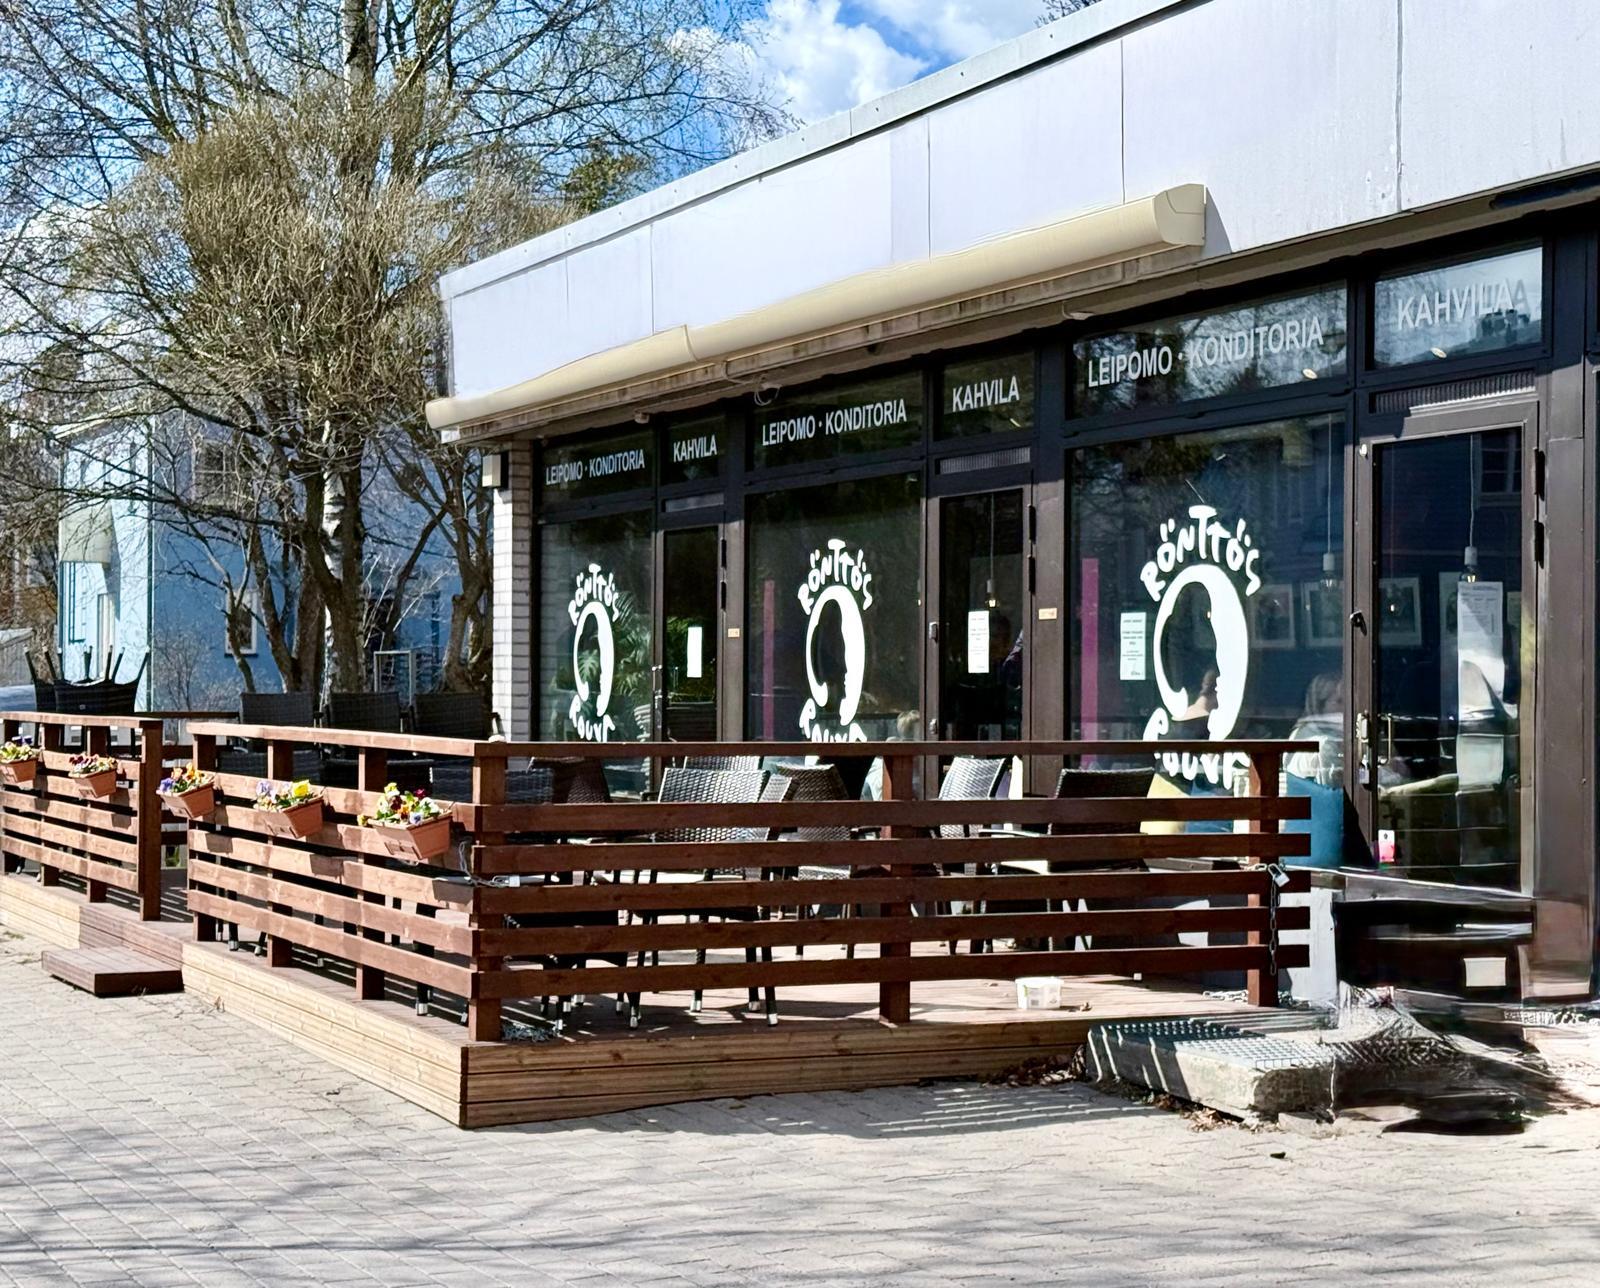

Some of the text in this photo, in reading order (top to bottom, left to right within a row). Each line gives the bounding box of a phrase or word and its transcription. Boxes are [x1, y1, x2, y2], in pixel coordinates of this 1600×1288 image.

[1399, 279, 1514, 330] KAHVILA
[1088, 316, 1324, 388] LEIPOMO KONDITORIA
[952, 376, 1020, 412] KAHVILA
[762, 398, 907, 446] LEIPOMO KONDITORIA
[546, 449, 645, 486] LEIPOMO KONDITORIA
[673, 434, 718, 463] KAHVILA
